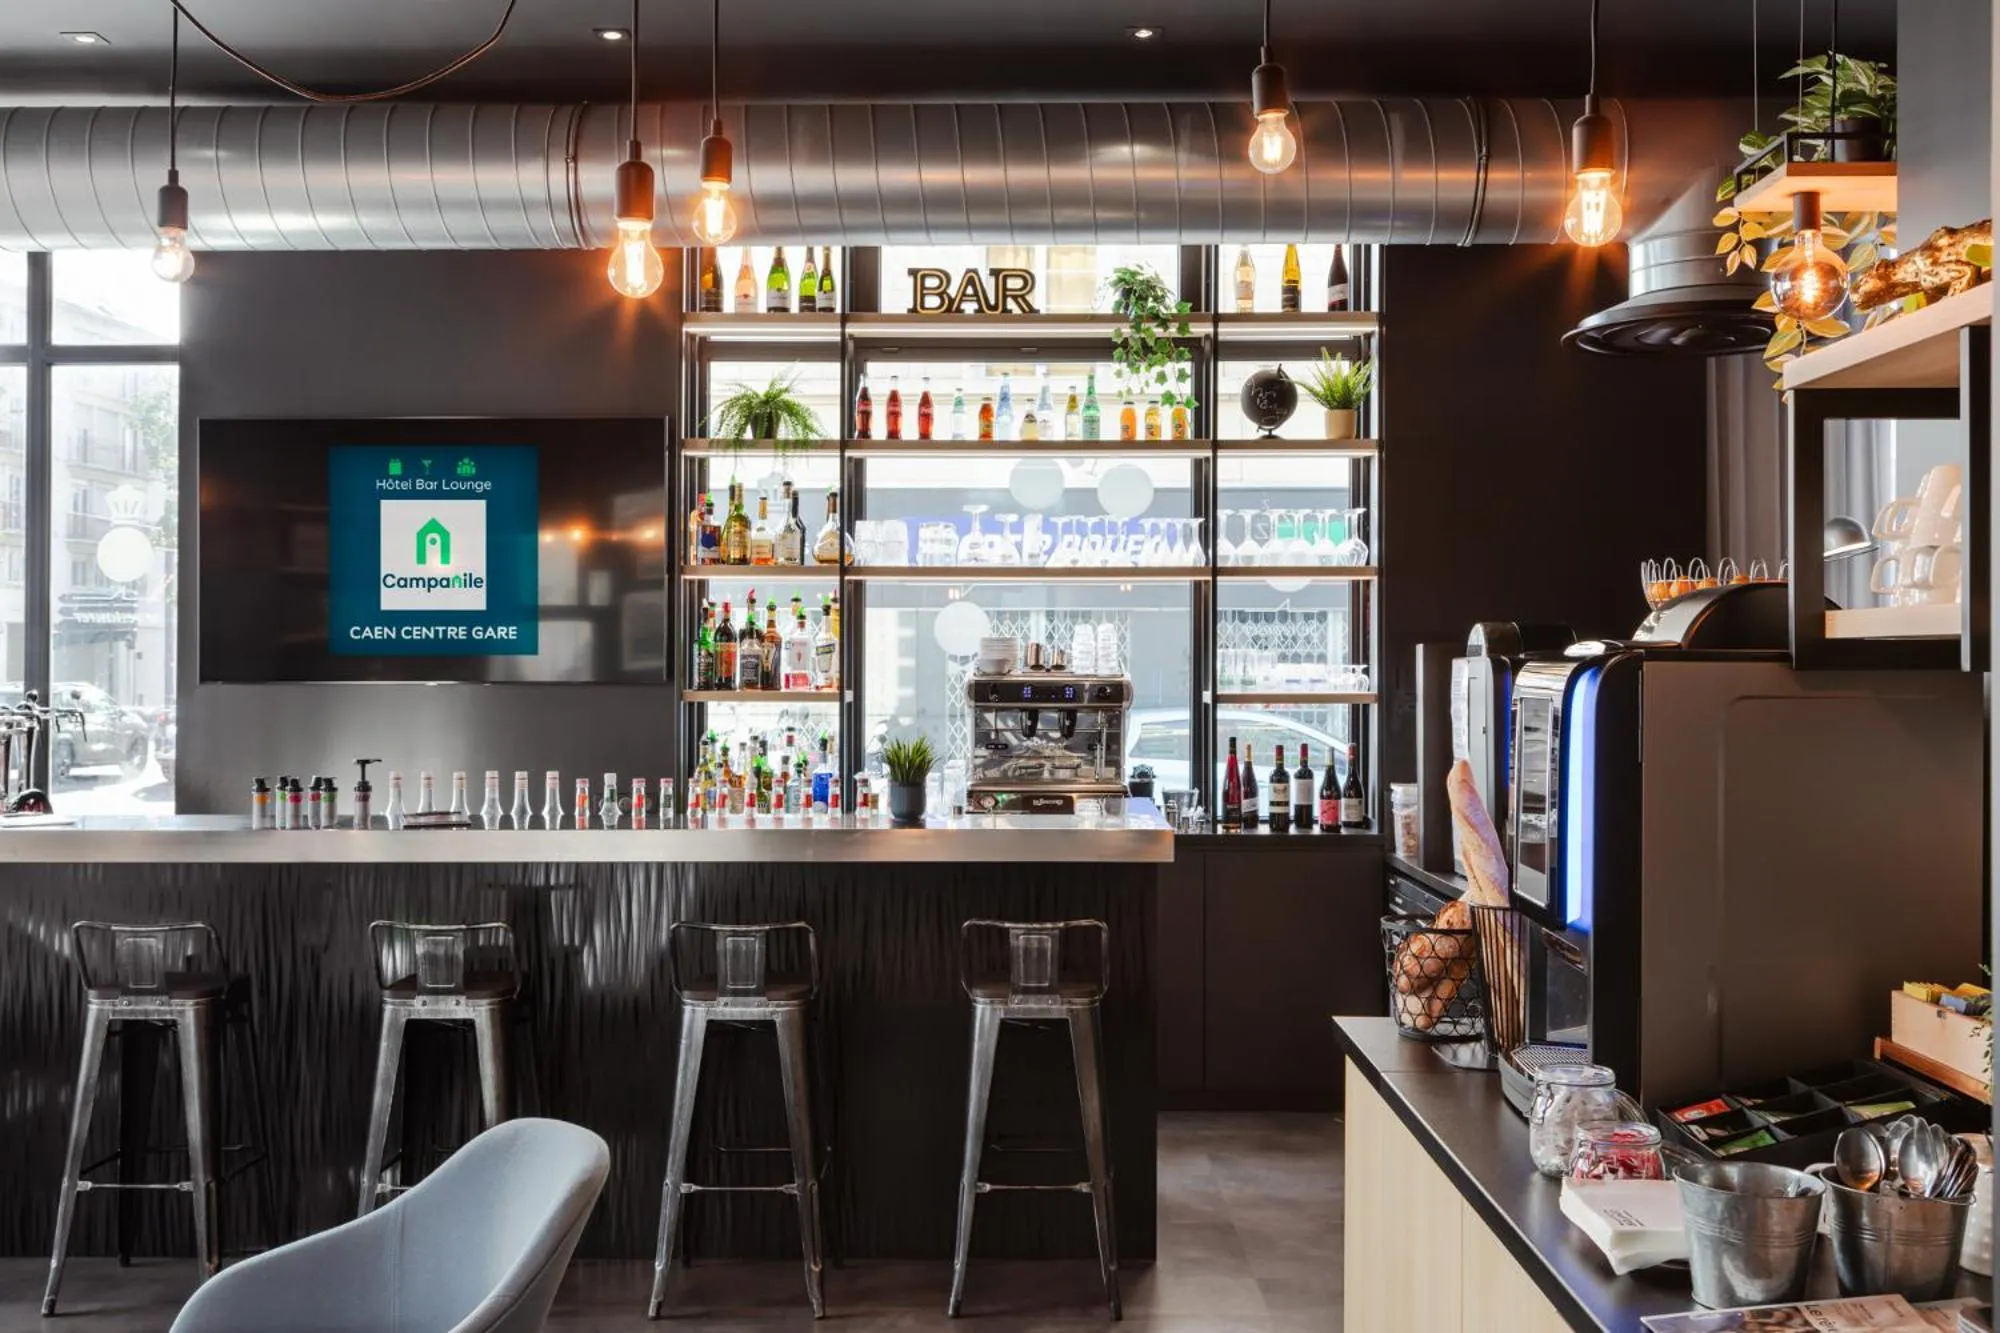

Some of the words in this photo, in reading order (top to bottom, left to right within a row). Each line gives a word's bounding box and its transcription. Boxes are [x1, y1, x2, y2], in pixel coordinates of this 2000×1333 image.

[908, 268, 1040, 314] BAR
[376, 479, 412, 490] Hôtel
[416, 479, 438, 490] Bar
[442, 479, 492, 493] Lounge
[382, 571, 484, 592] Campanile
[350, 626, 396, 640] CAEN
[401, 626, 467, 640] CENTRE
[472, 626, 517, 640] GARE
